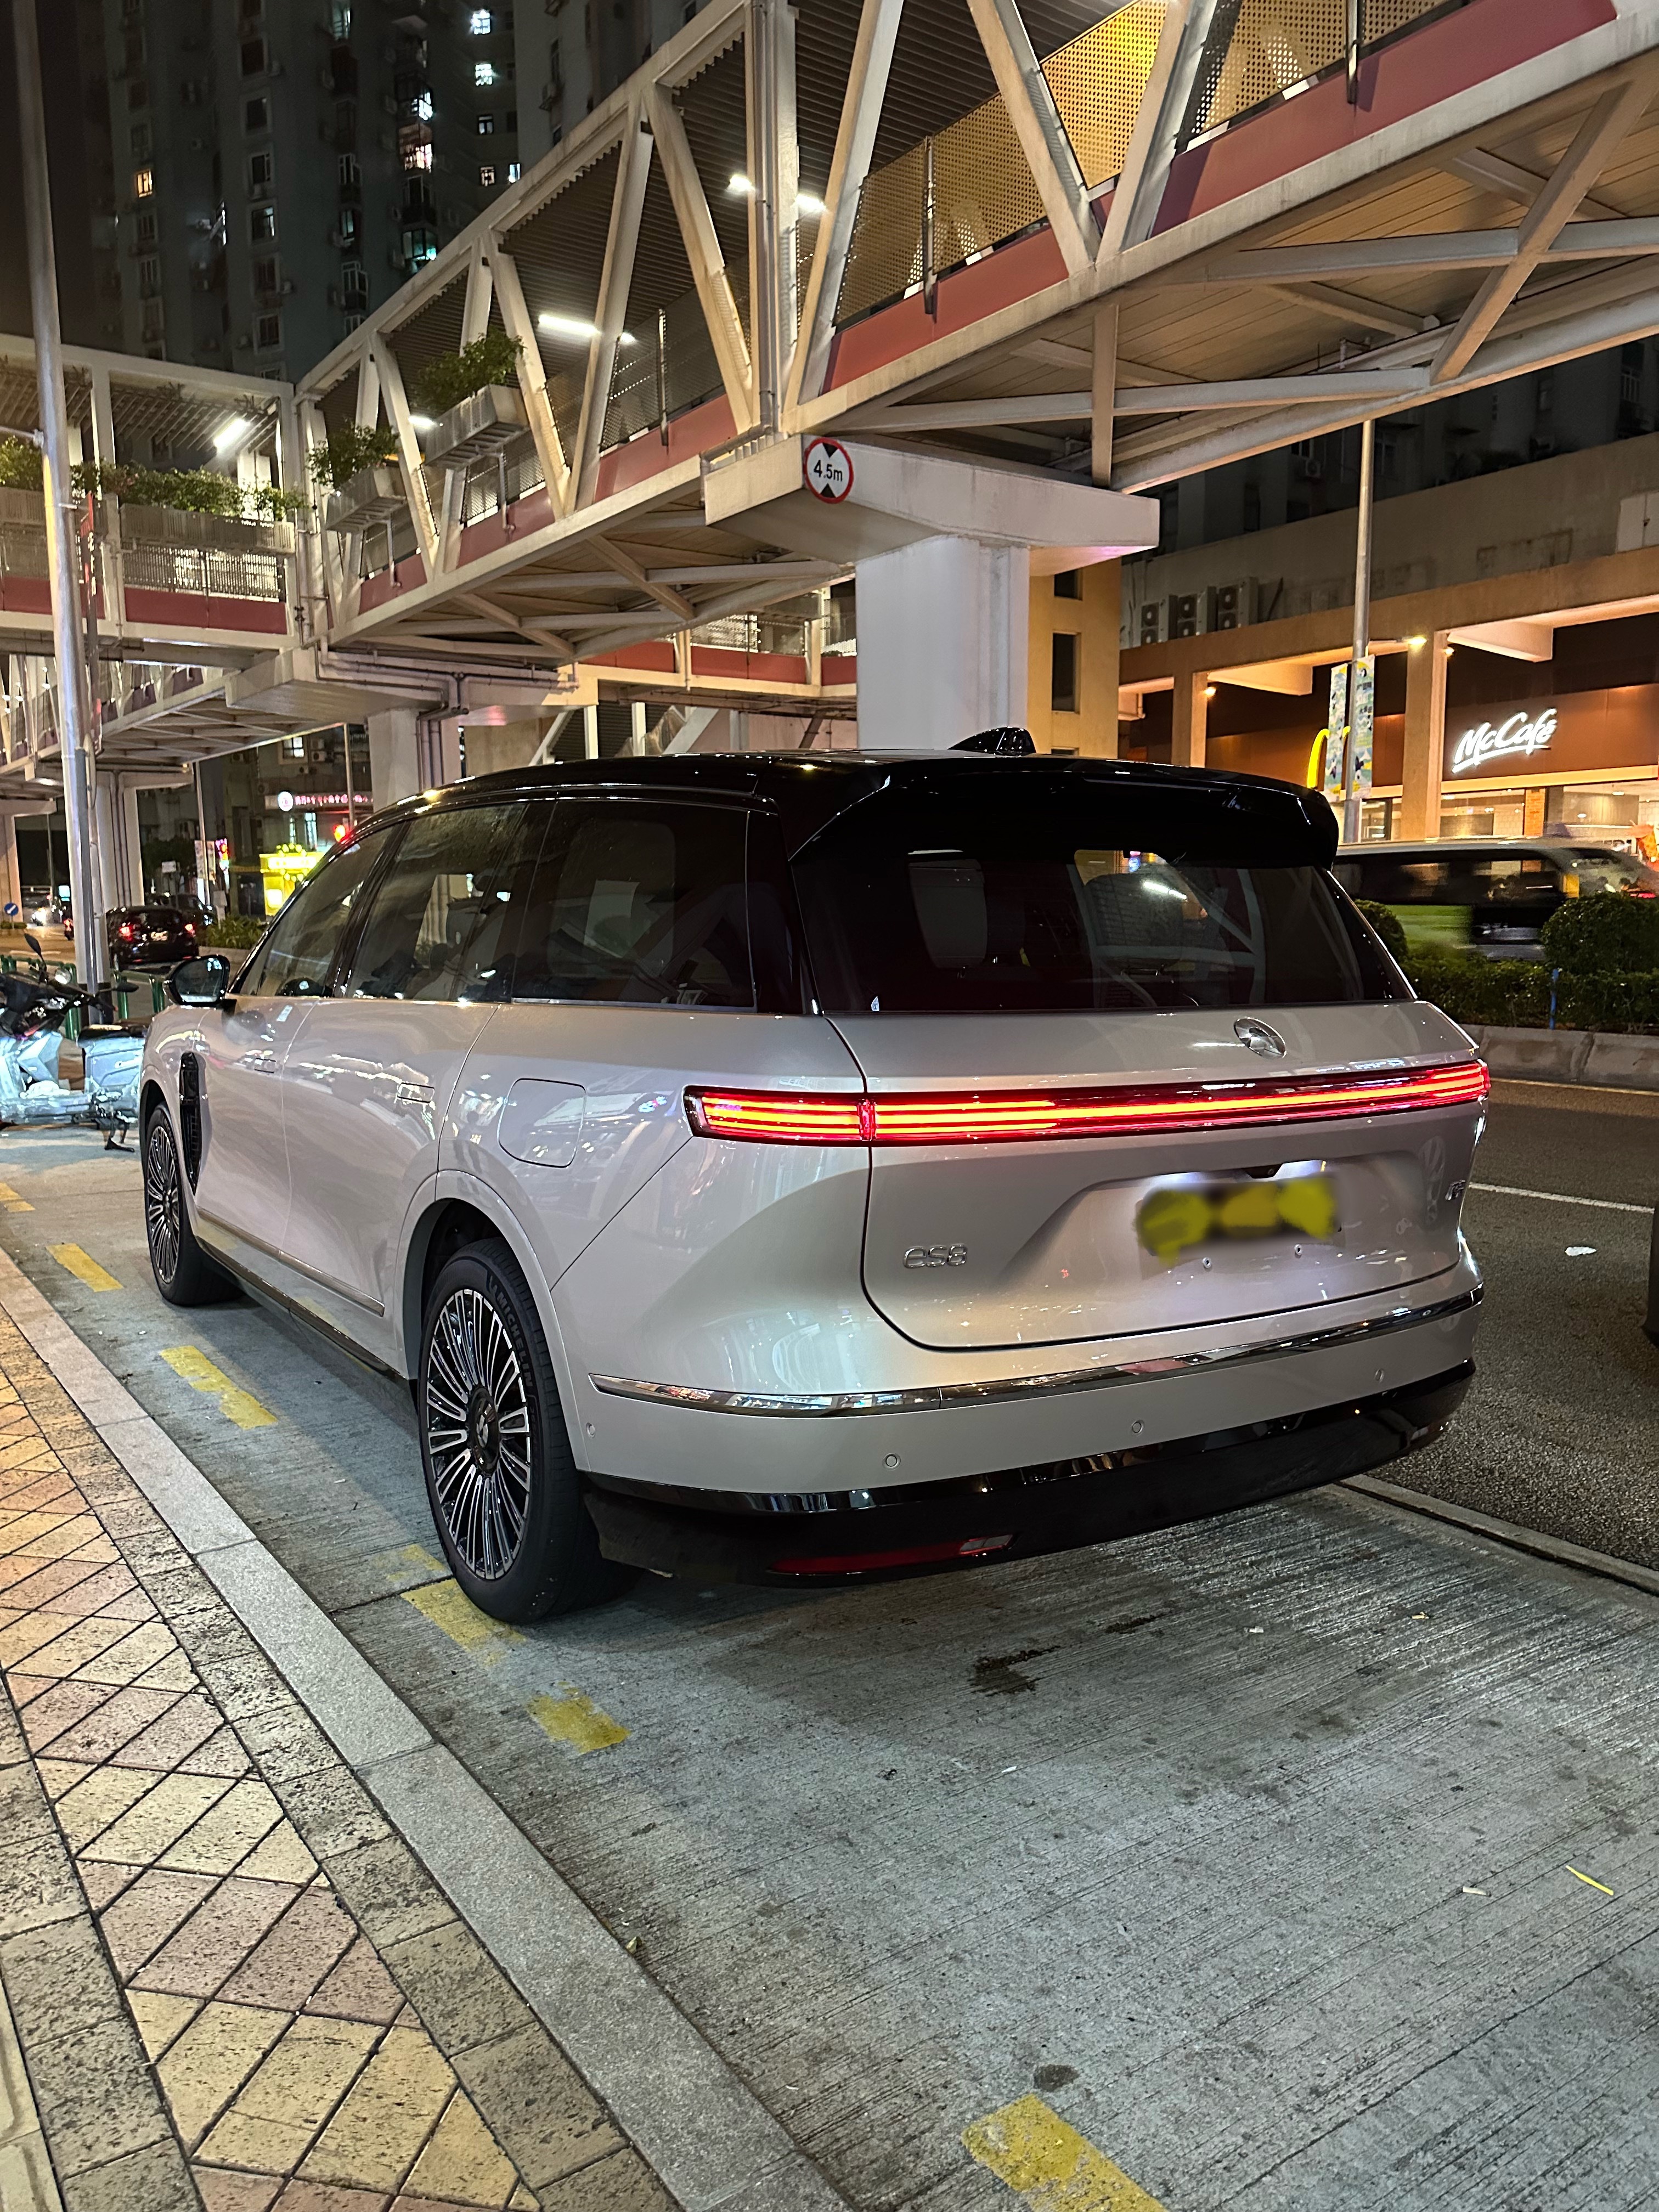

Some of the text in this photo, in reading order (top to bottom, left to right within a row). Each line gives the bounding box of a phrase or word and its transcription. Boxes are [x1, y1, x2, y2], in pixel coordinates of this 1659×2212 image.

[814, 460, 843, 482] 4.5m
[1453, 707, 1557, 767] McCafé
[496, 1291, 533, 1387] MICHELIN
